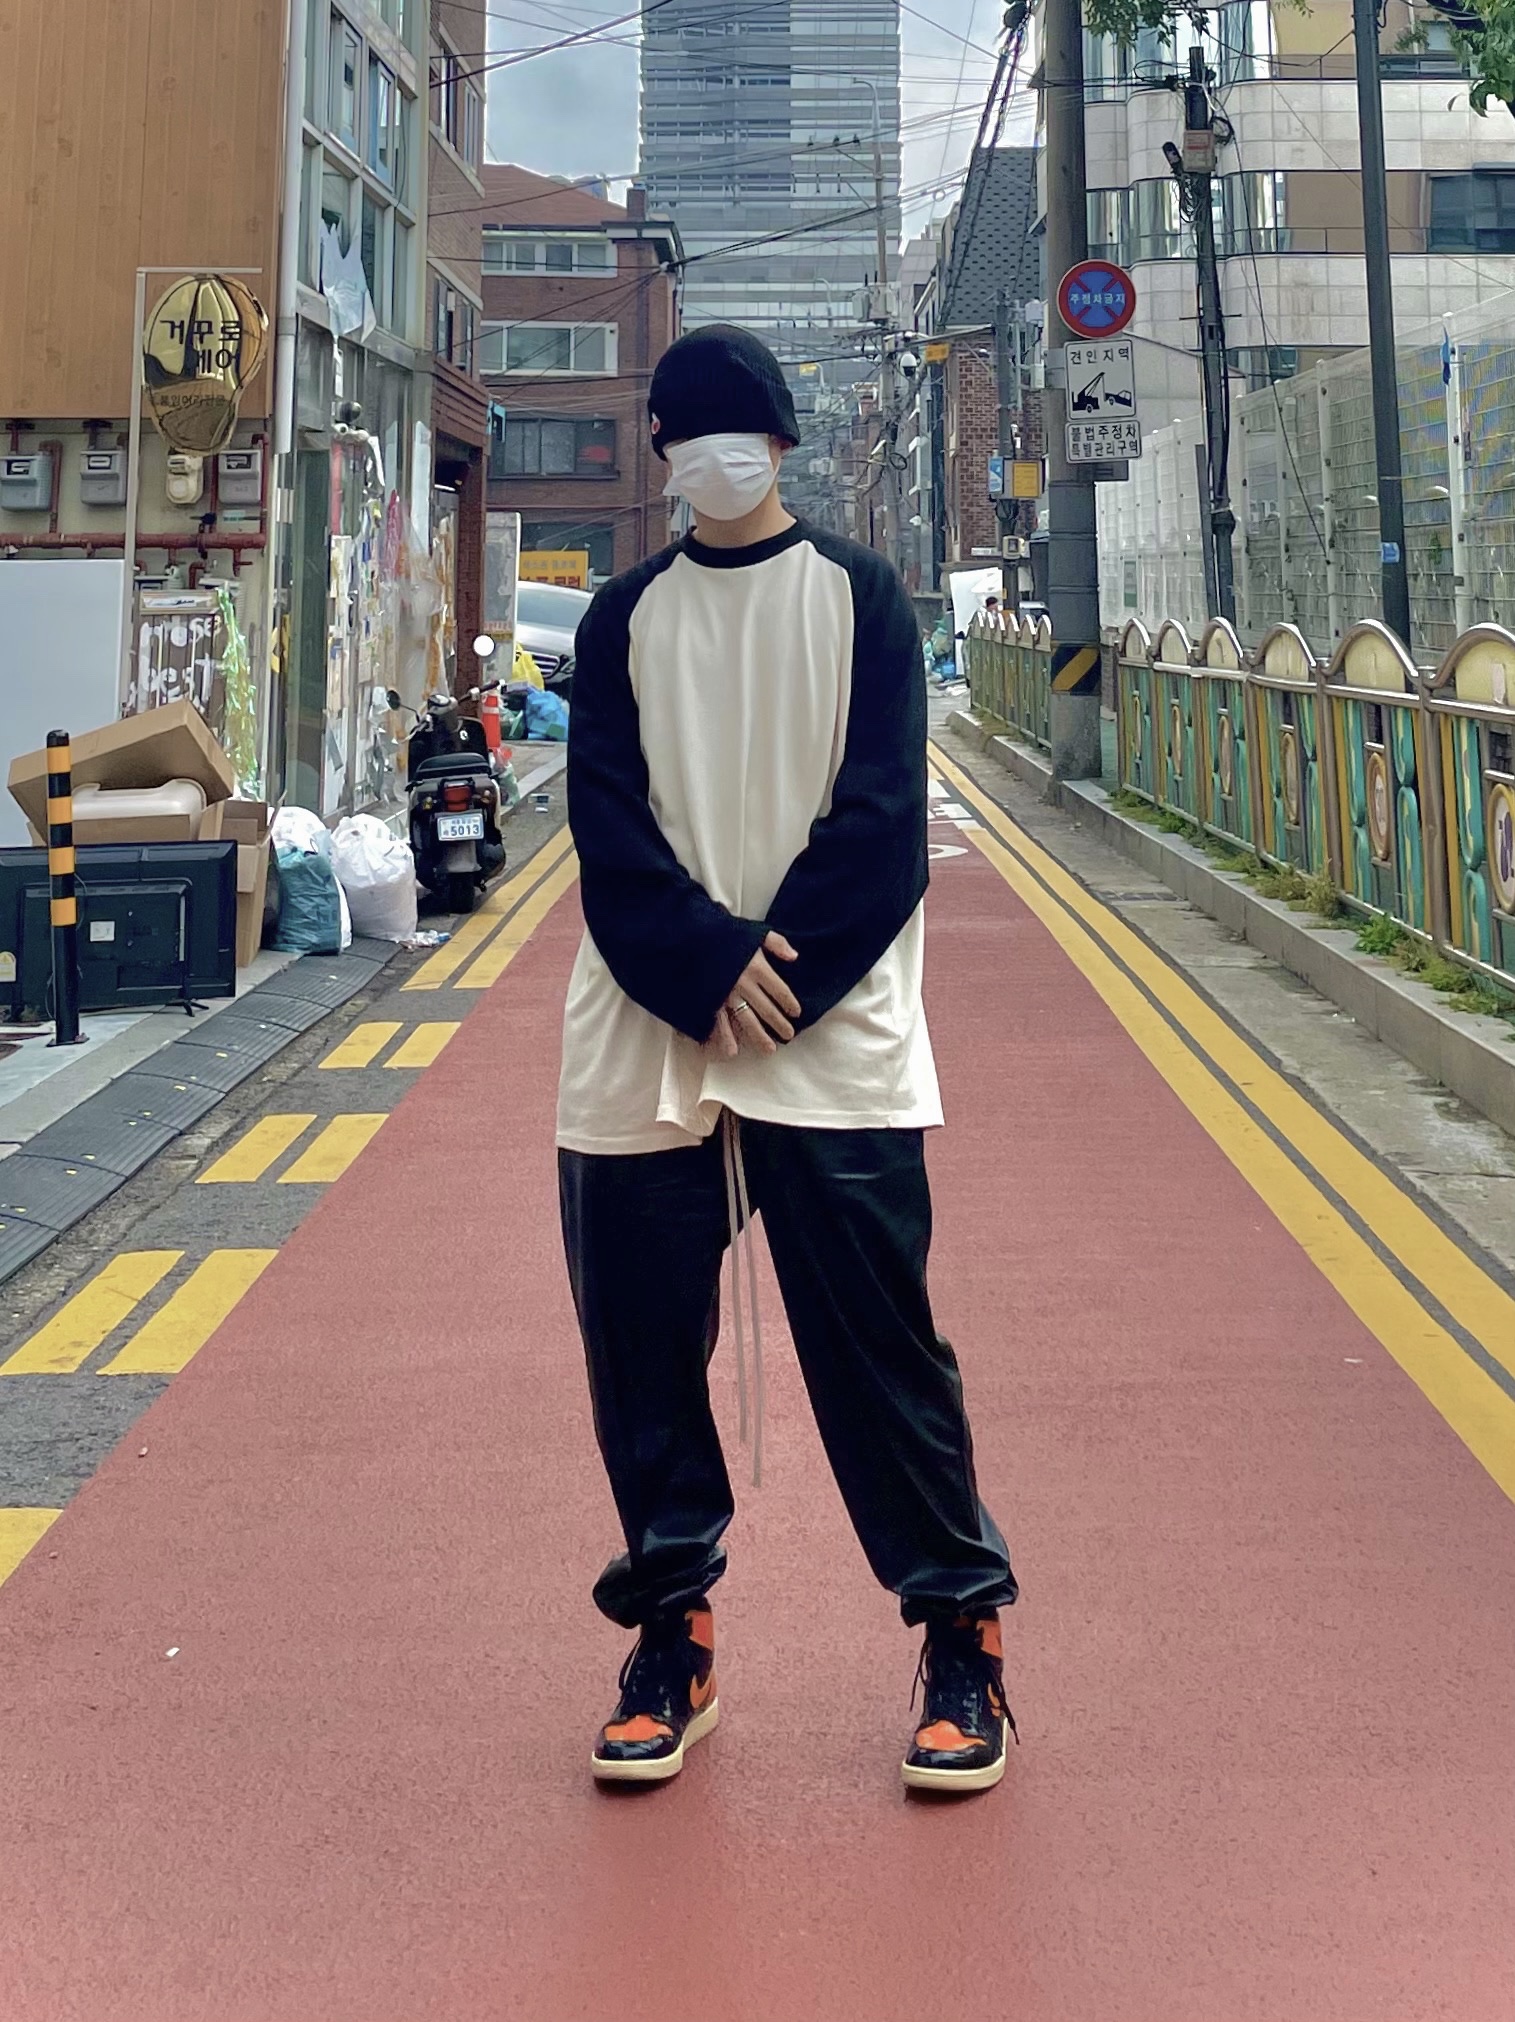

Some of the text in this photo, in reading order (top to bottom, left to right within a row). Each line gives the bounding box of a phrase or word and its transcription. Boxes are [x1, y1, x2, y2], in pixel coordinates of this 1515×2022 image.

[1070, 292, 1126, 305] 주정차금지
[159, 319, 241, 345] 거꾸로
[1070, 346, 1130, 365] 견인지역
[1071, 424, 1136, 442] 불법주정차
[1071, 440, 1138, 458] 특별관리구역
[451, 824, 480, 837] 5013
